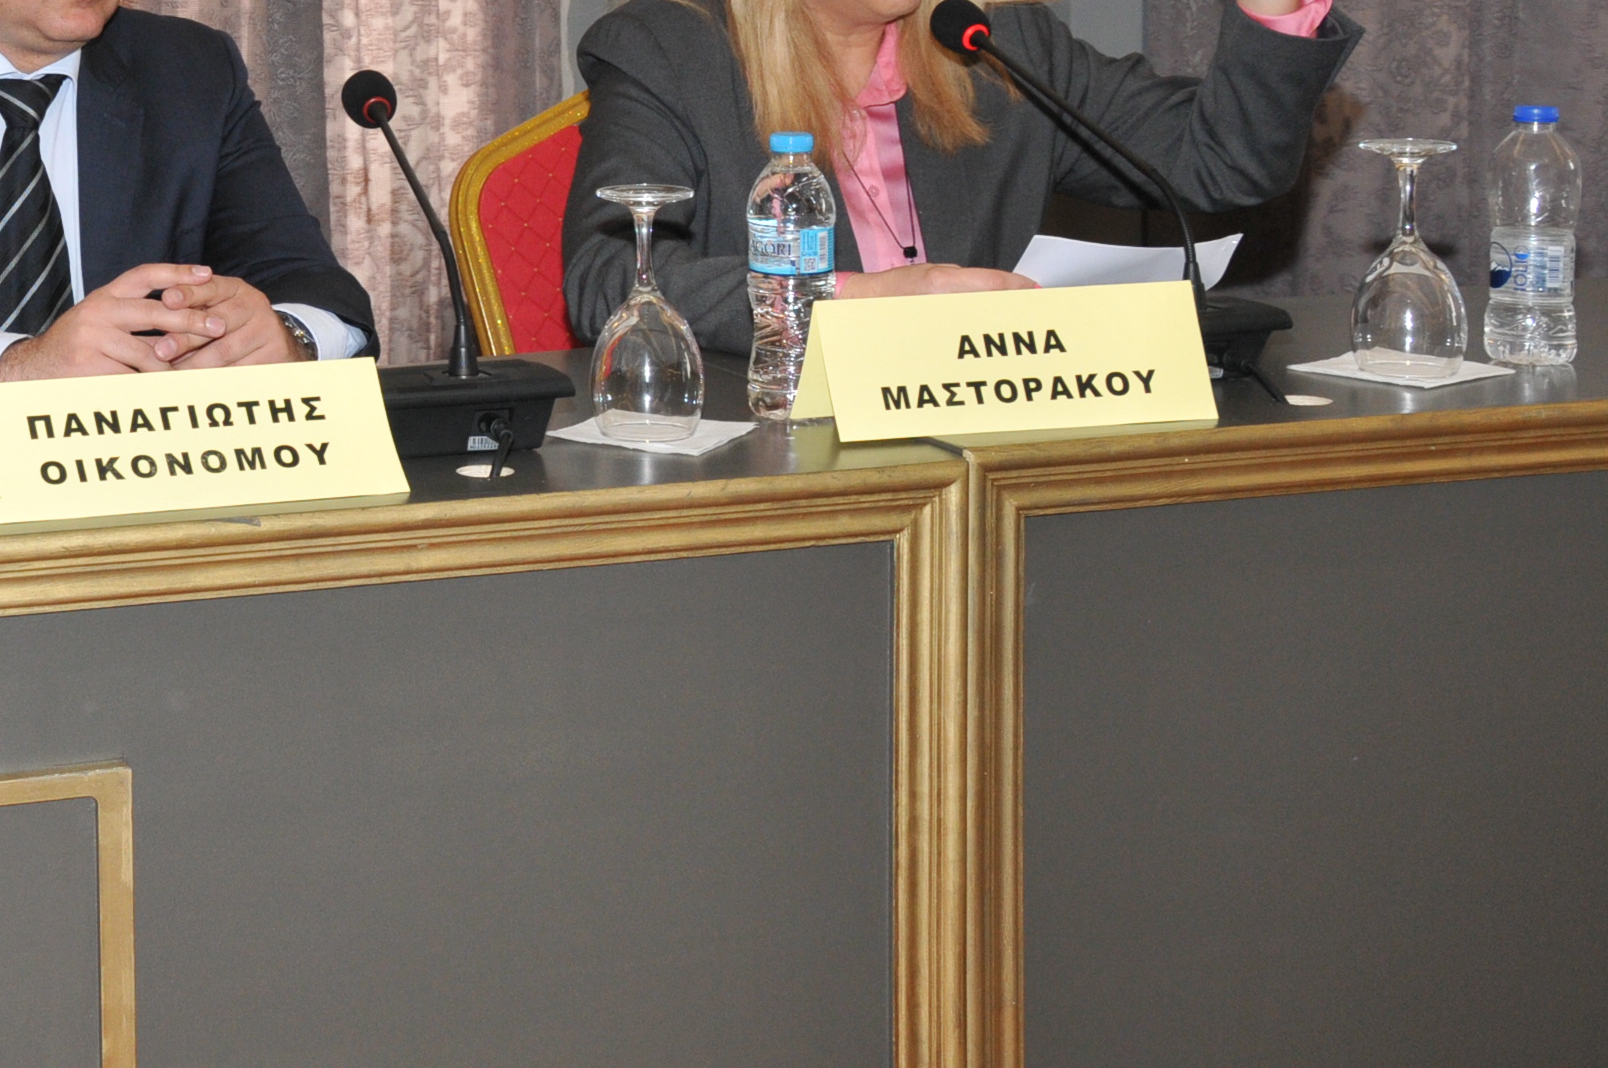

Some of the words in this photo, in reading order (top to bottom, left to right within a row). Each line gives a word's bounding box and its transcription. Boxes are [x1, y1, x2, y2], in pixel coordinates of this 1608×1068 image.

[957, 329, 1066, 360] ΑΝΝΑ
[881, 369, 1156, 410] ΜΑΣΤΟΡΑΚΟΥ
[27, 396, 326, 439] ΠΑΝΑΓΙΩΤΗΣ
[40, 442, 330, 485] ΟΙΚΟΝΟΜΟΥ
